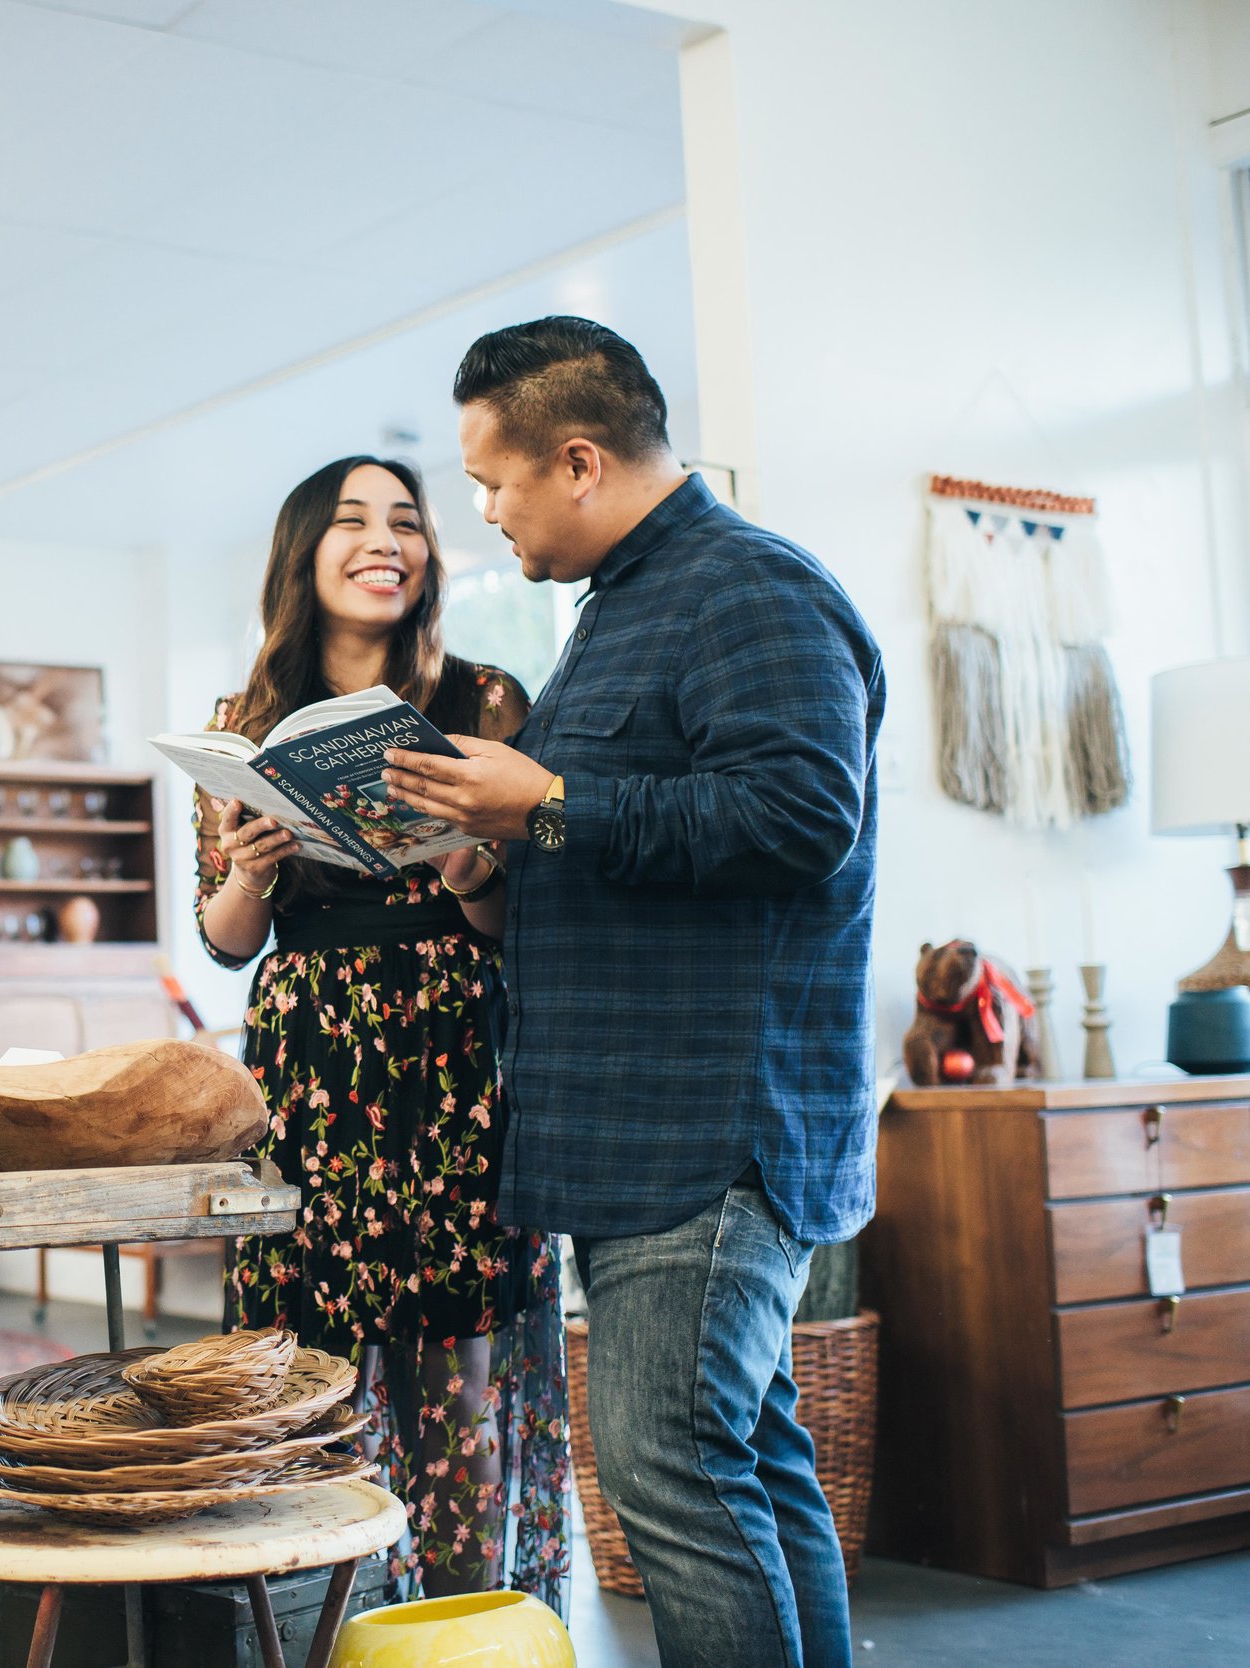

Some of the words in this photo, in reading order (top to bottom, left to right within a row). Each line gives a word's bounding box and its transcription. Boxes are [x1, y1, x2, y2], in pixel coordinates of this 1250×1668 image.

[288, 715, 420, 763] SCANDINAVIAN
[314, 731, 420, 771] GATHERINGS
[278, 779, 333, 827] SCANDINAVIAN
[331, 825, 375, 863] GATHERINGS
